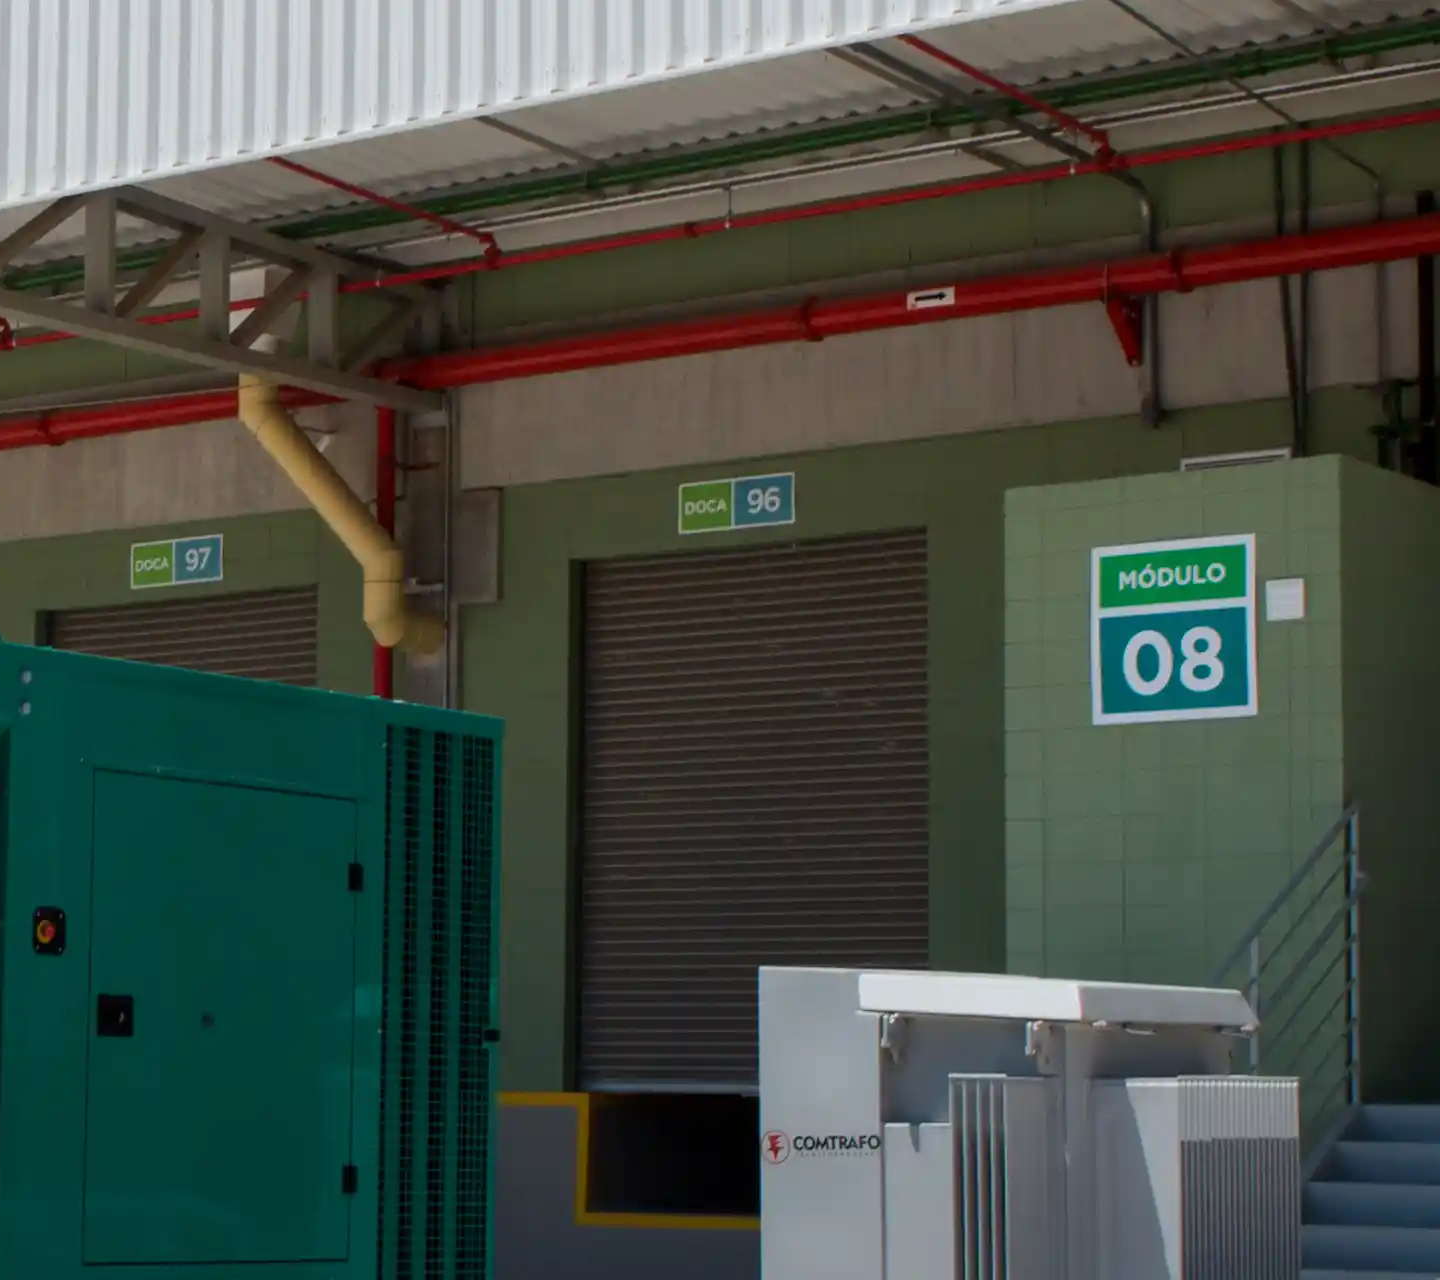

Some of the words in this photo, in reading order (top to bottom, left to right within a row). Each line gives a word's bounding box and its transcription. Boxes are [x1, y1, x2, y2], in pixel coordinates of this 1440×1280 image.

[684, 498, 728, 516] DOCA
[746, 486, 781, 515] 96
[134, 556, 170, 573] DOCA
[185, 546, 212, 572] 97
[1118, 562, 1227, 591] MÓDULO
[1122, 626, 1225, 696] 08
[792, 1134, 881, 1151] COMTRAFO
